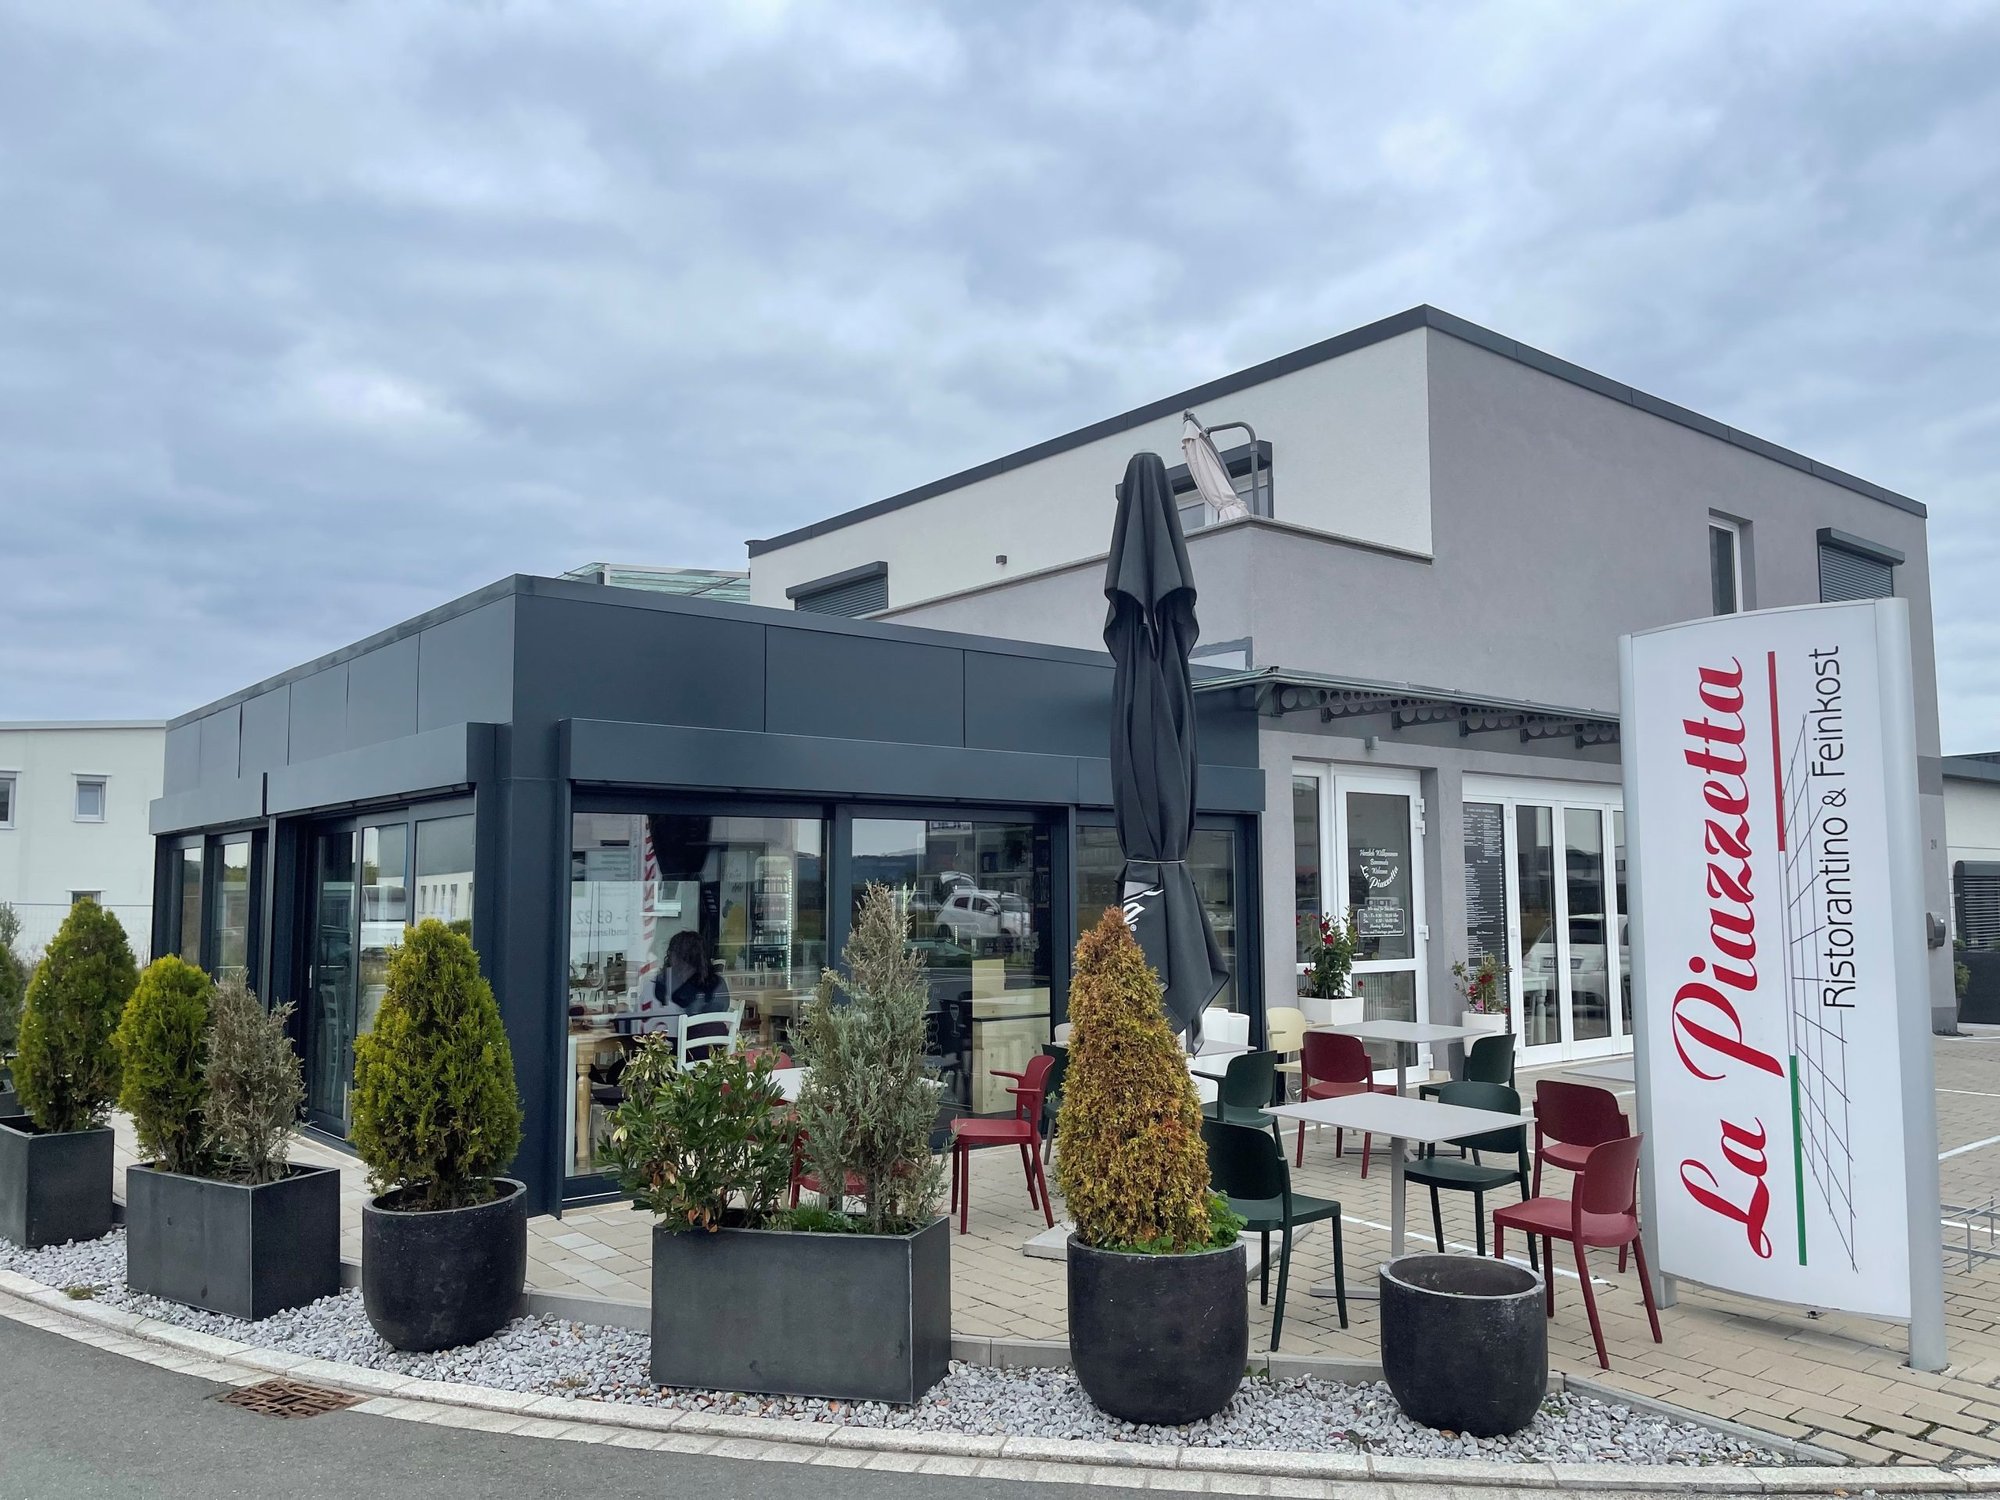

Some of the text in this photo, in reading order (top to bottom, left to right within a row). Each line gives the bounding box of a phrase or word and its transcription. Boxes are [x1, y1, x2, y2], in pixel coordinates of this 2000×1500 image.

[1672, 655, 1784, 1260] La Piazzetta
[1808, 645, 1856, 1008] Ristorantino & Feinkost
